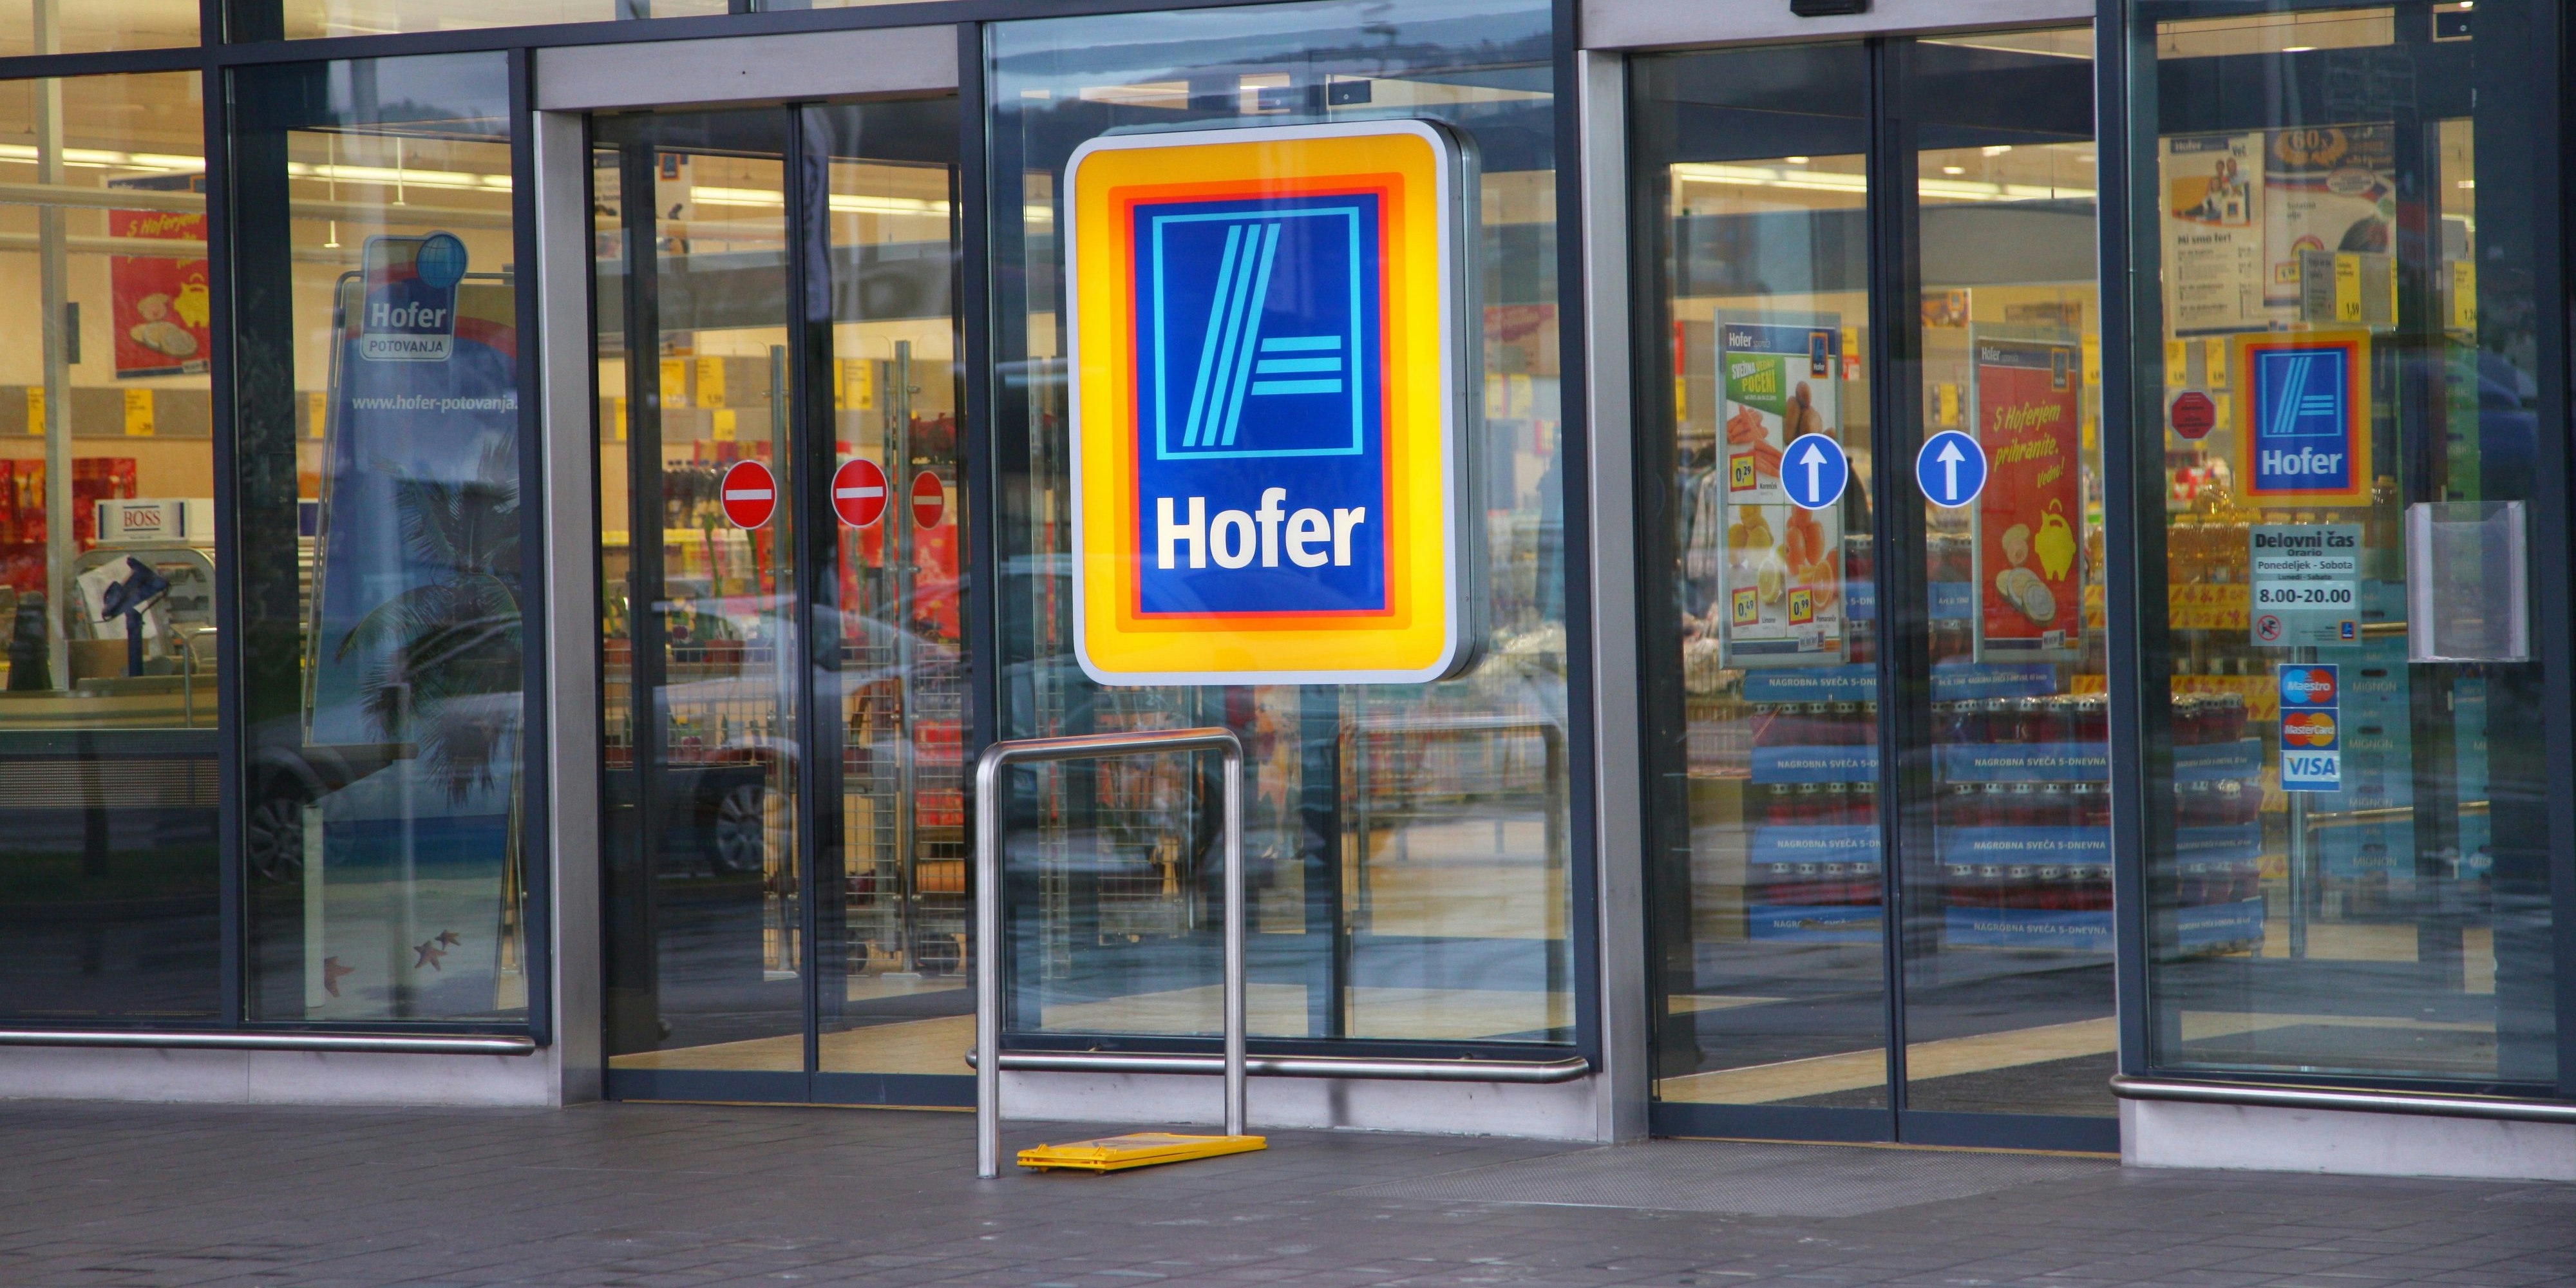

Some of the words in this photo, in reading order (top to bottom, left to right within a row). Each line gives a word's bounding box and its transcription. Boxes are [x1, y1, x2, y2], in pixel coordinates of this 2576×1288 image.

[371, 301, 446, 328] Hofer
[1729, 332, 1752, 347] Hofer
[369, 341, 444, 352] POTOVANJA
[1982, 346, 2000, 361] Hofer
[1732, 360, 1756, 380] SVEŽINA
[1742, 369, 1776, 393] POCENI
[1993, 406, 2003, 433] S
[2005, 399, 2061, 433] Hoferjem
[1994, 432, 2059, 472] prihranite.
[2262, 446, 2342, 475] Hofer
[124, 510, 160, 527] BOSS
[1157, 487, 1365, 569] Hofer
[2255, 531, 2322, 547] Delovni
[2327, 531, 2355, 547] čas
[2258, 560, 2311, 571] Ponedeljek
[2320, 561, 2353, 569] Sobota
[2259, 589, 2351, 603] 8.00-20.00
[1794, 600, 1809, 616] 0,99
[1769, 678, 1817, 687] NAGROBNA
[1820, 676, 1848, 687] SVEČA
[2287, 681, 2331, 691] Maestro
[2353, 682, 2397, 692] MIGNON
[2284, 725, 2335, 735] MasterCard
[2349, 739, 2393, 749] MIGNON
[1777, 760, 1827, 769] NAGROBNA
[1830, 758, 1859, 768] SVEČA
[1975, 758, 2025, 766] NAGROBNA
[2028, 756, 2056, 766] SVEČA
[2058, 757, 2107, 766] 5-DNEVNA
[2287, 757, 2336, 775] VISA
[2349, 797, 2393, 808] MIGNON
[1777, 839, 1827, 848] NAGROBNA
[1829, 838, 1858, 848] SVEČA
[1974, 842, 2024, 850] NAGROBNA
[2027, 839, 2056, 849] SVEČA
[2058, 841, 2106, 850] 5-DNEVNA
[2353, 856, 2397, 867] MIGNON
[1974, 923, 2025, 933] NAGROBNA
[2027, 923, 2056, 934] SVEČA
[2059, 925, 2107, 935] 5-DNEVNA
